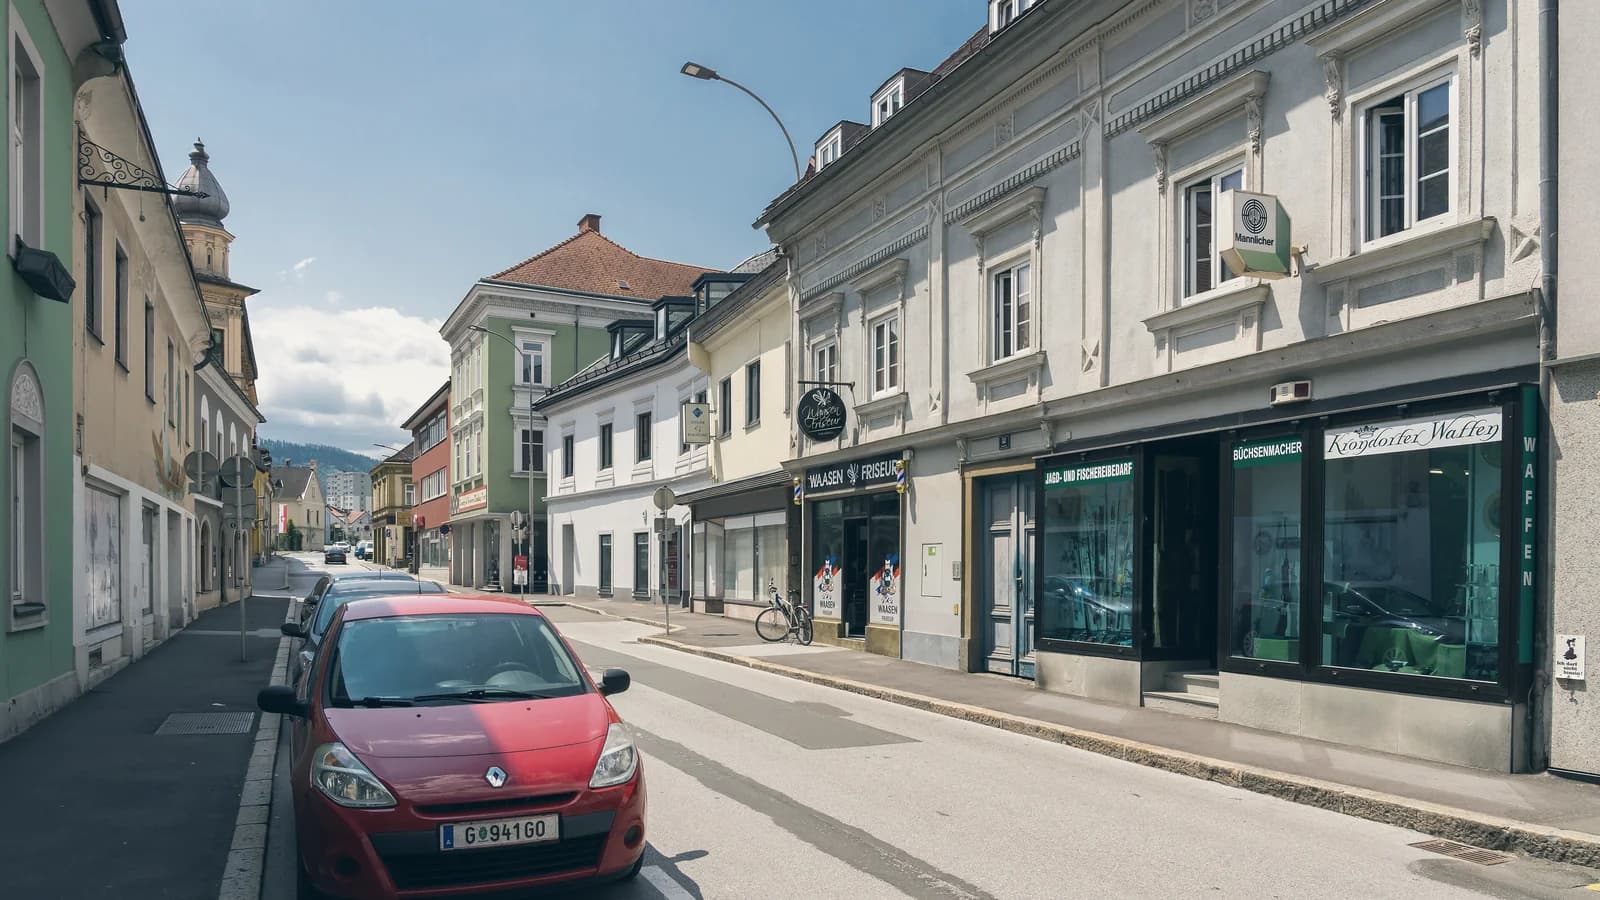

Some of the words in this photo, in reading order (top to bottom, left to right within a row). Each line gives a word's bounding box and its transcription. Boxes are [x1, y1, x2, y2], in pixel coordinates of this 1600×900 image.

[1234, 233, 1274, 246] Mannlicher
[1327, 427, 1428, 456] Krondorfer
[1429, 414, 1500, 443] Waffen
[1233, 440, 1303, 462] BÜCHSENMACHER
[809, 469, 844, 489] WAASEN
[861, 459, 898, 481] FRISEUR
[1045, 471, 1063, 486] JAGD-
[1063, 469, 1076, 483] UND
[1076, 461, 1134, 481] FISCHEREIBEDARF
[1522, 436, 1537, 587] WAFFEN
[878, 604, 898, 615] WAASEN
[465, 826, 476, 845] G
